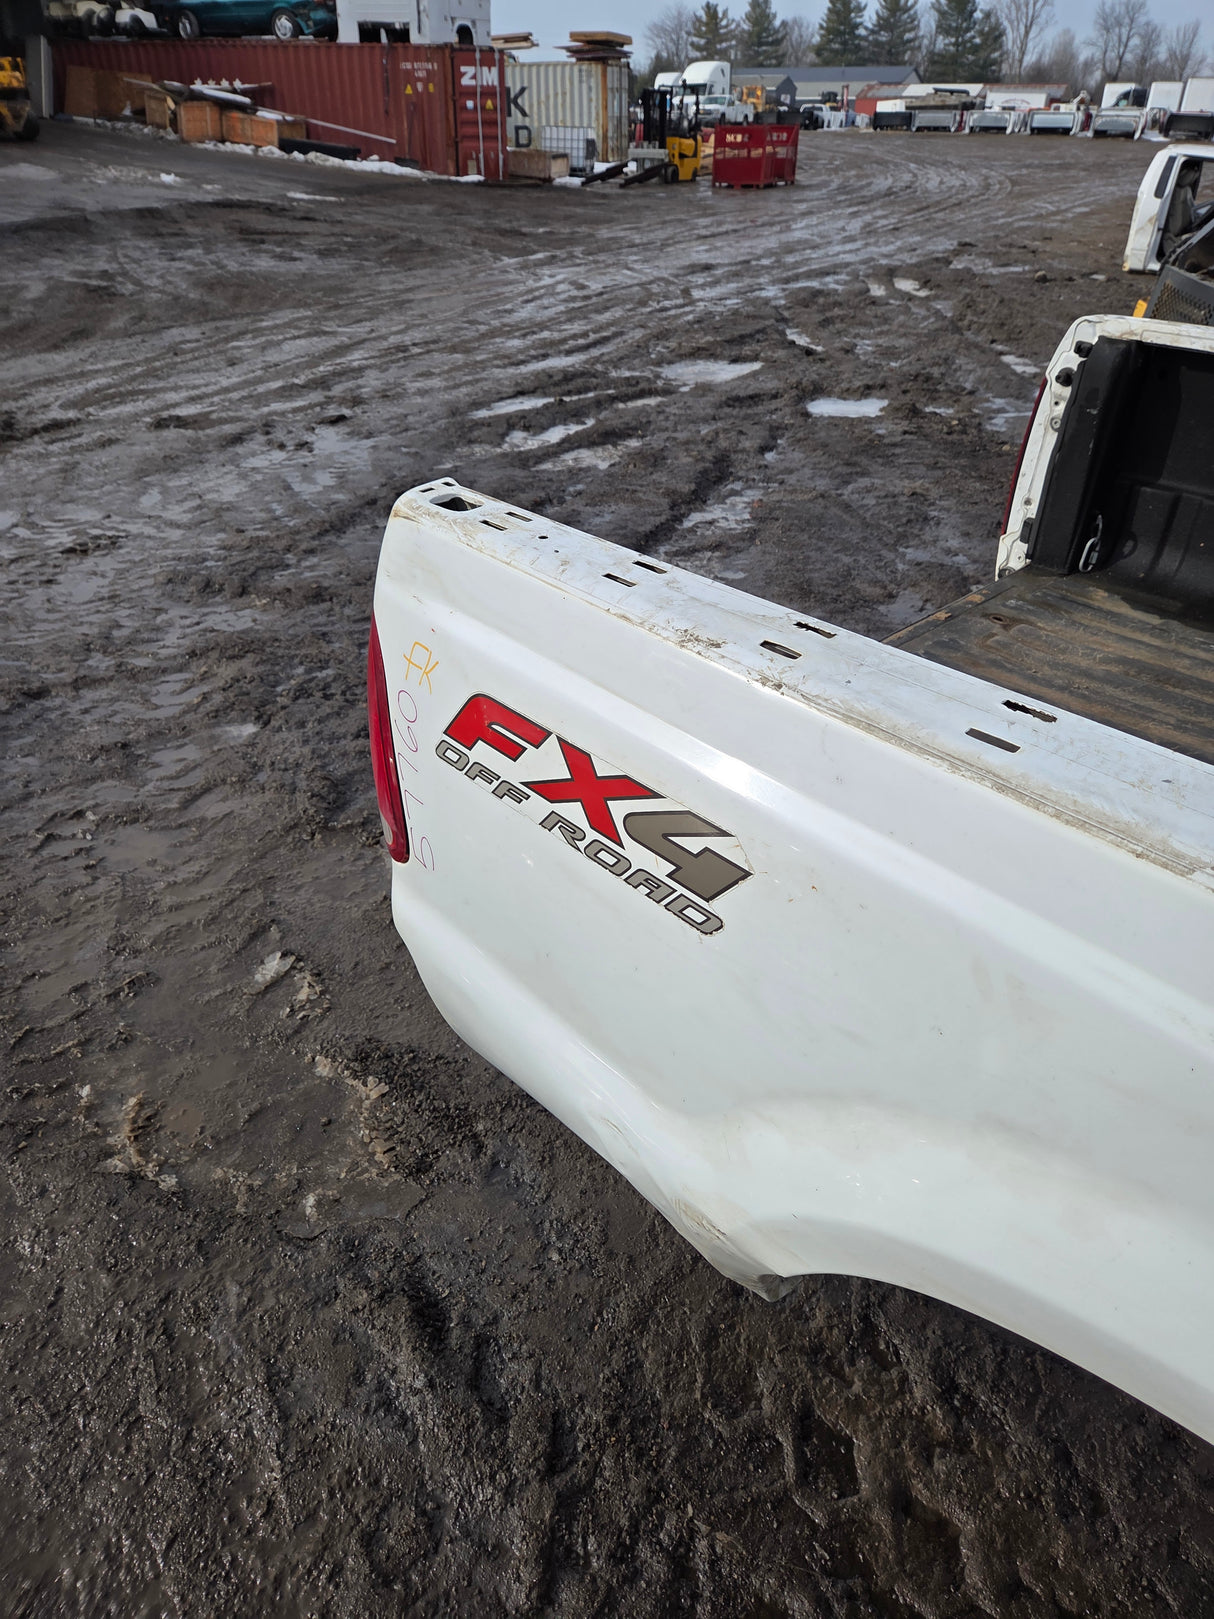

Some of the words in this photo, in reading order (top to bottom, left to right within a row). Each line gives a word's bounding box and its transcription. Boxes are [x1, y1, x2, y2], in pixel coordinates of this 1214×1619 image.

[460, 66, 499, 86] ZM
[514, 125, 532, 148] D
[435, 739, 531, 805] OFF
[539, 810, 724, 936] ROAD
[443, 693, 754, 903] FX4
